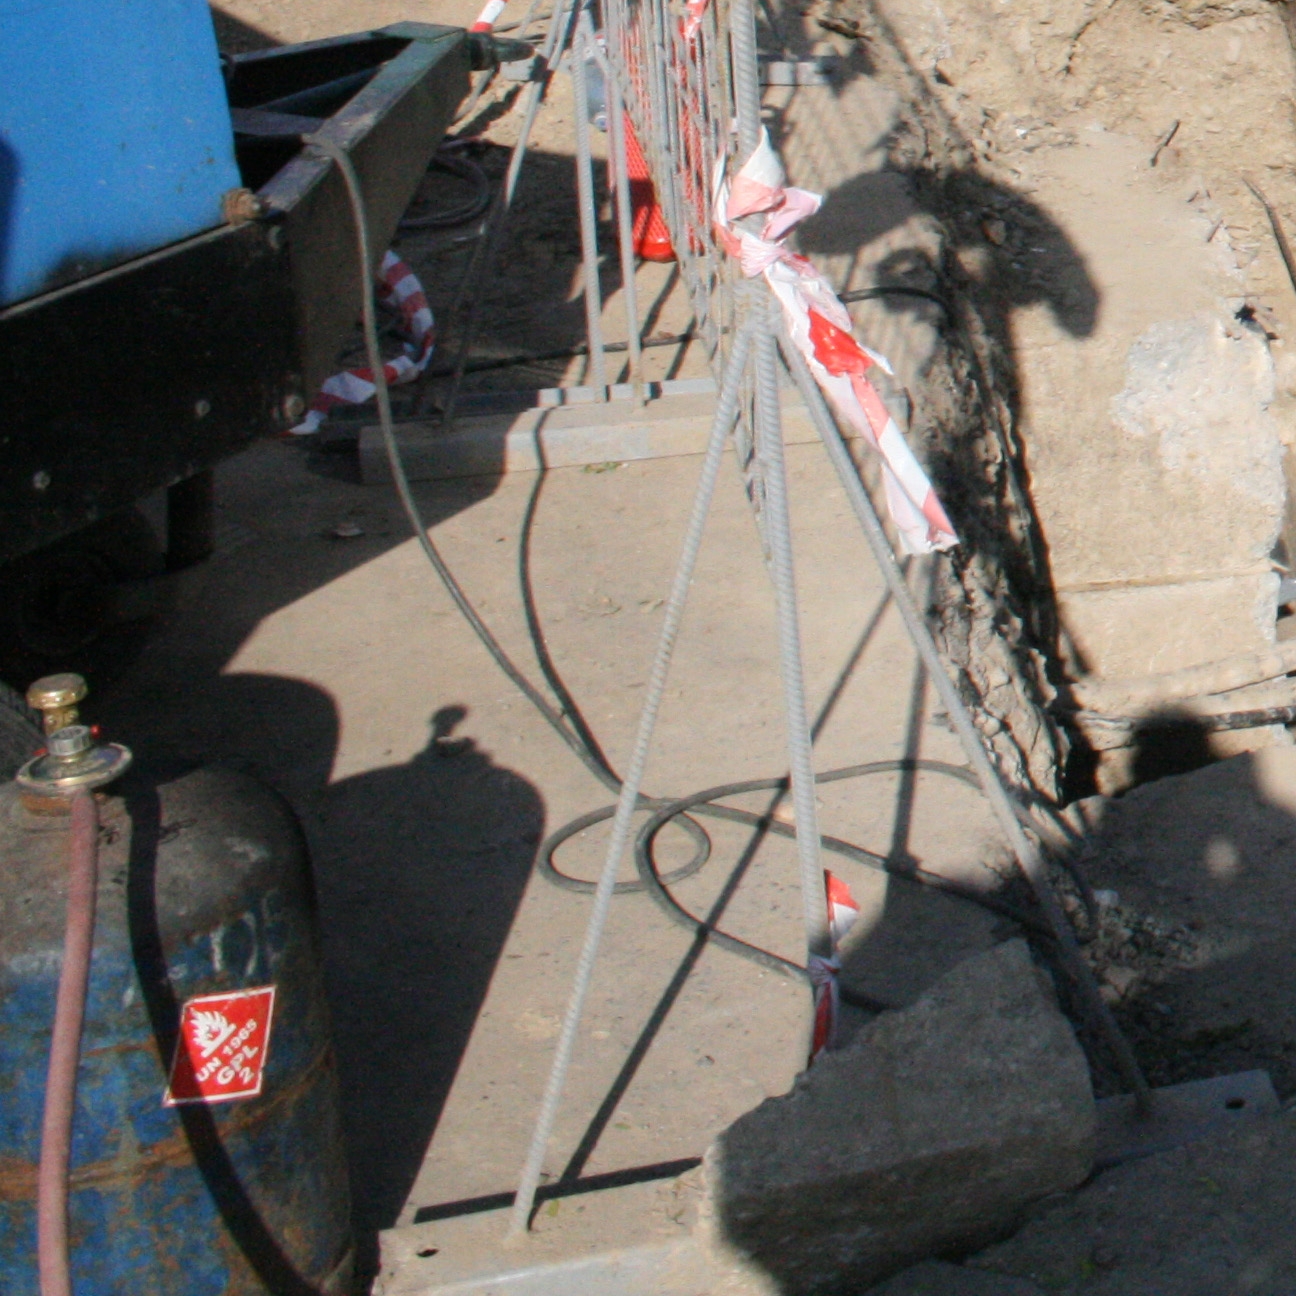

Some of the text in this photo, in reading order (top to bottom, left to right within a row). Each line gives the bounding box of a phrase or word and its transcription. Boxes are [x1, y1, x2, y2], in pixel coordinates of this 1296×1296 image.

[196, 1018, 257, 1082] UN 1965
[216, 1045, 259, 1085] GPL
[239, 1066, 254, 1084] 2
